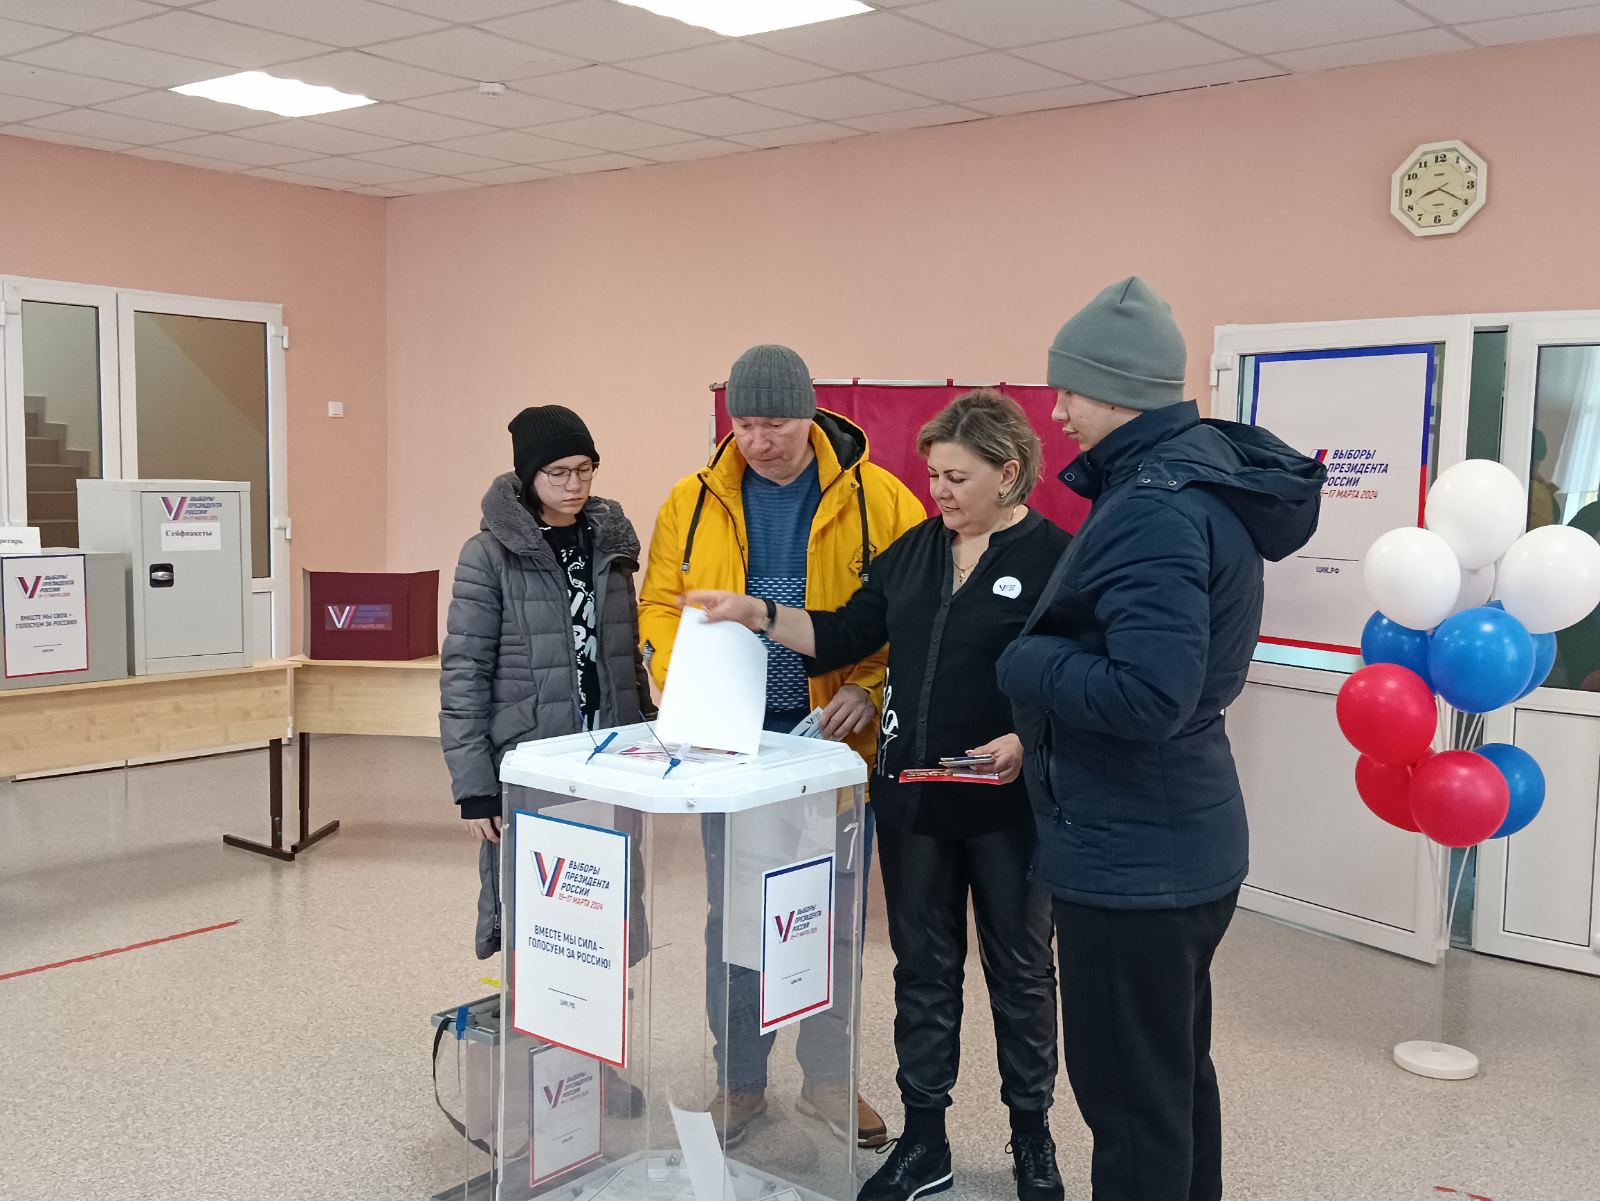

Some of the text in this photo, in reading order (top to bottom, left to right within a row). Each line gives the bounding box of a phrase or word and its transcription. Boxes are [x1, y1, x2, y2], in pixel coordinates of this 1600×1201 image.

[1434, 154, 1447, 164] 12
[1407, 172, 1418, 181] 10
[1466, 180, 1475, 190] 3
[1404, 188, 1413, 197] 9
[1407, 204, 1414, 212] 8
[1451, 209, 1459, 217] 5
[1418, 214, 1423, 222] 7
[1433, 214, 1442, 224] 6
[1332, 449, 1376, 460] ВЫБОРЫ
[1327, 463, 1389, 474] ПРЕЗИДЕНТА
[1325, 476, 1361, 487] ОССИИ
[1336, 490, 1359, 498] МАРТА
[1360, 490, 1378, 499] 2024
[568, 860, 601, 876] ВЫБОРЫ
[564, 871, 610, 889] ПРЕЗИДЕНТА
[561, 882, 591, 897] РОССИИ
[534, 924, 562, 942] ВМЕСТЕ
[562, 932, 577, 945] МЫ
[577, 937, 598, 951] СИЛА
[528, 936, 612, 970] ГОЛОСУЕМ ЗА РОССИЮ!
